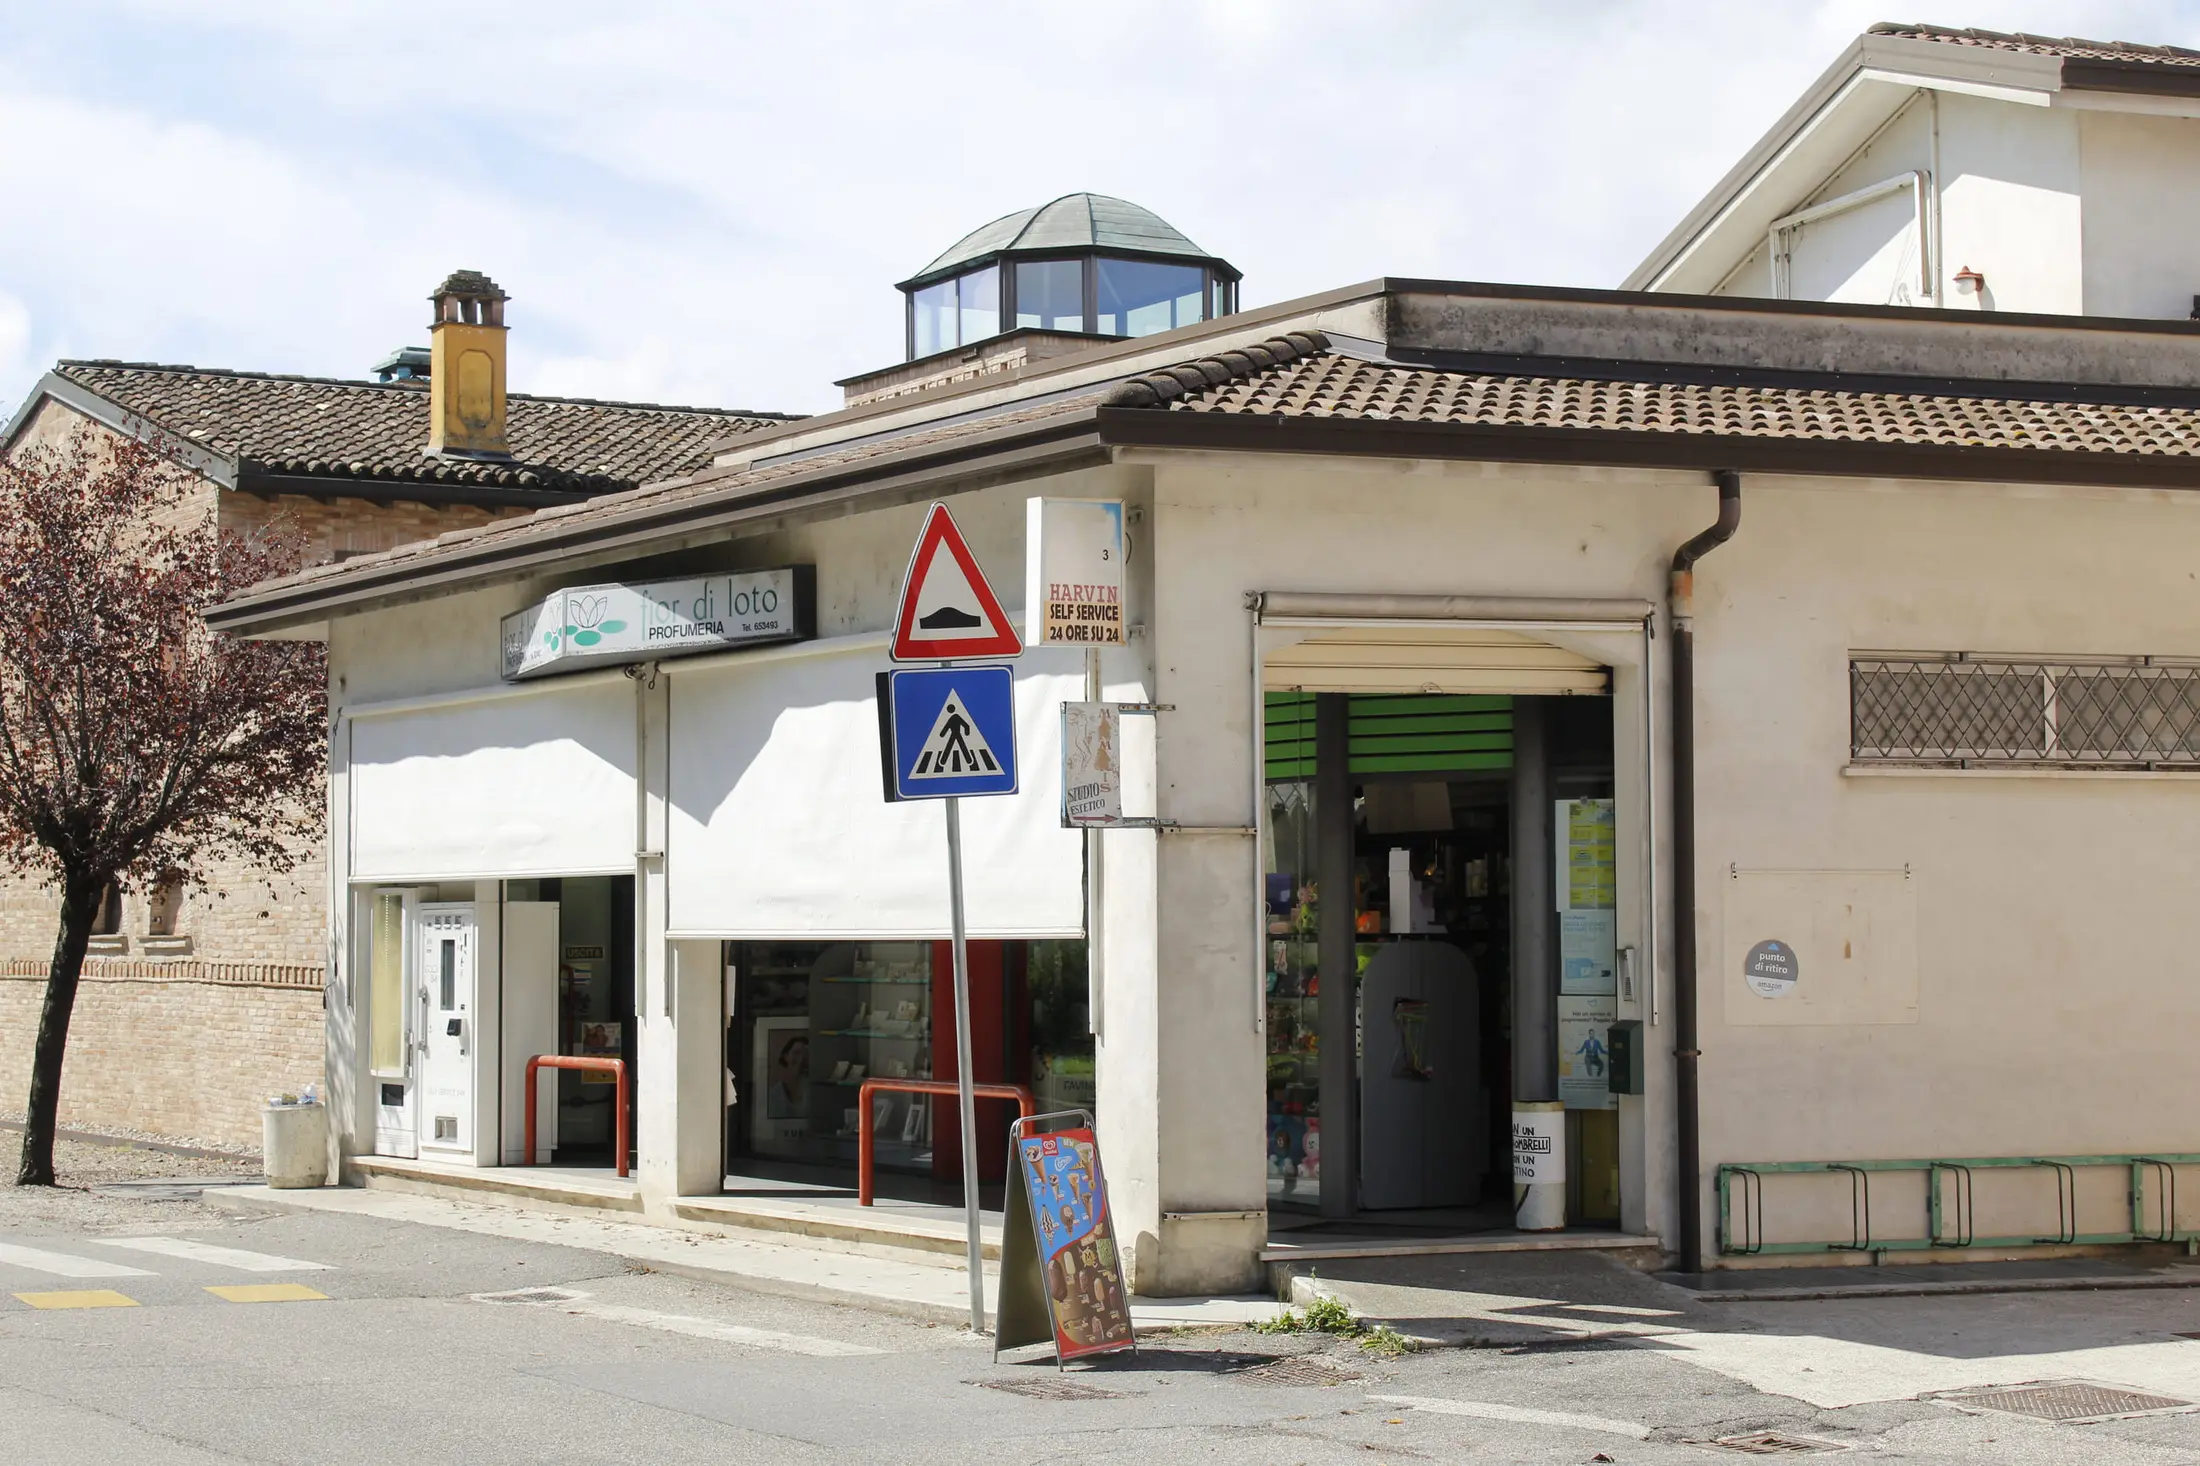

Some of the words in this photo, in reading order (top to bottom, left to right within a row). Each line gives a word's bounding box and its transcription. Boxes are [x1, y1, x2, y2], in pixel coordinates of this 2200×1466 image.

[1050, 583, 1118, 603] HARVIN
[693, 581, 714, 621] di
[729, 578, 778, 617] loto
[1050, 603, 1074, 620] SELF
[1076, 604, 1119, 621] SERVICE
[649, 620, 725, 640] PROFUMERIA
[754, 620, 779, 631] 653493
[1050, 626, 1063, 640] 24
[1065, 624, 1089, 641] ORE
[1090, 625, 1104, 641] SU
[1106, 627, 1119, 642] 24
[1068, 783, 1101, 803] STUDIO
[1070, 799, 1105, 815] ESTETICO
[1759, 953, 1786, 961] punto
[1754, 962, 1763, 971] di
[1765, 963, 1788, 974] ritiro
[1757, 981, 1782, 990] amazon
[1522, 1126, 1535, 1136] UN
[1514, 1138, 1548, 1150] OMBRELLI
[1523, 1156, 1535, 1165] UN
[1514, 1166, 1535, 1178] TINO
